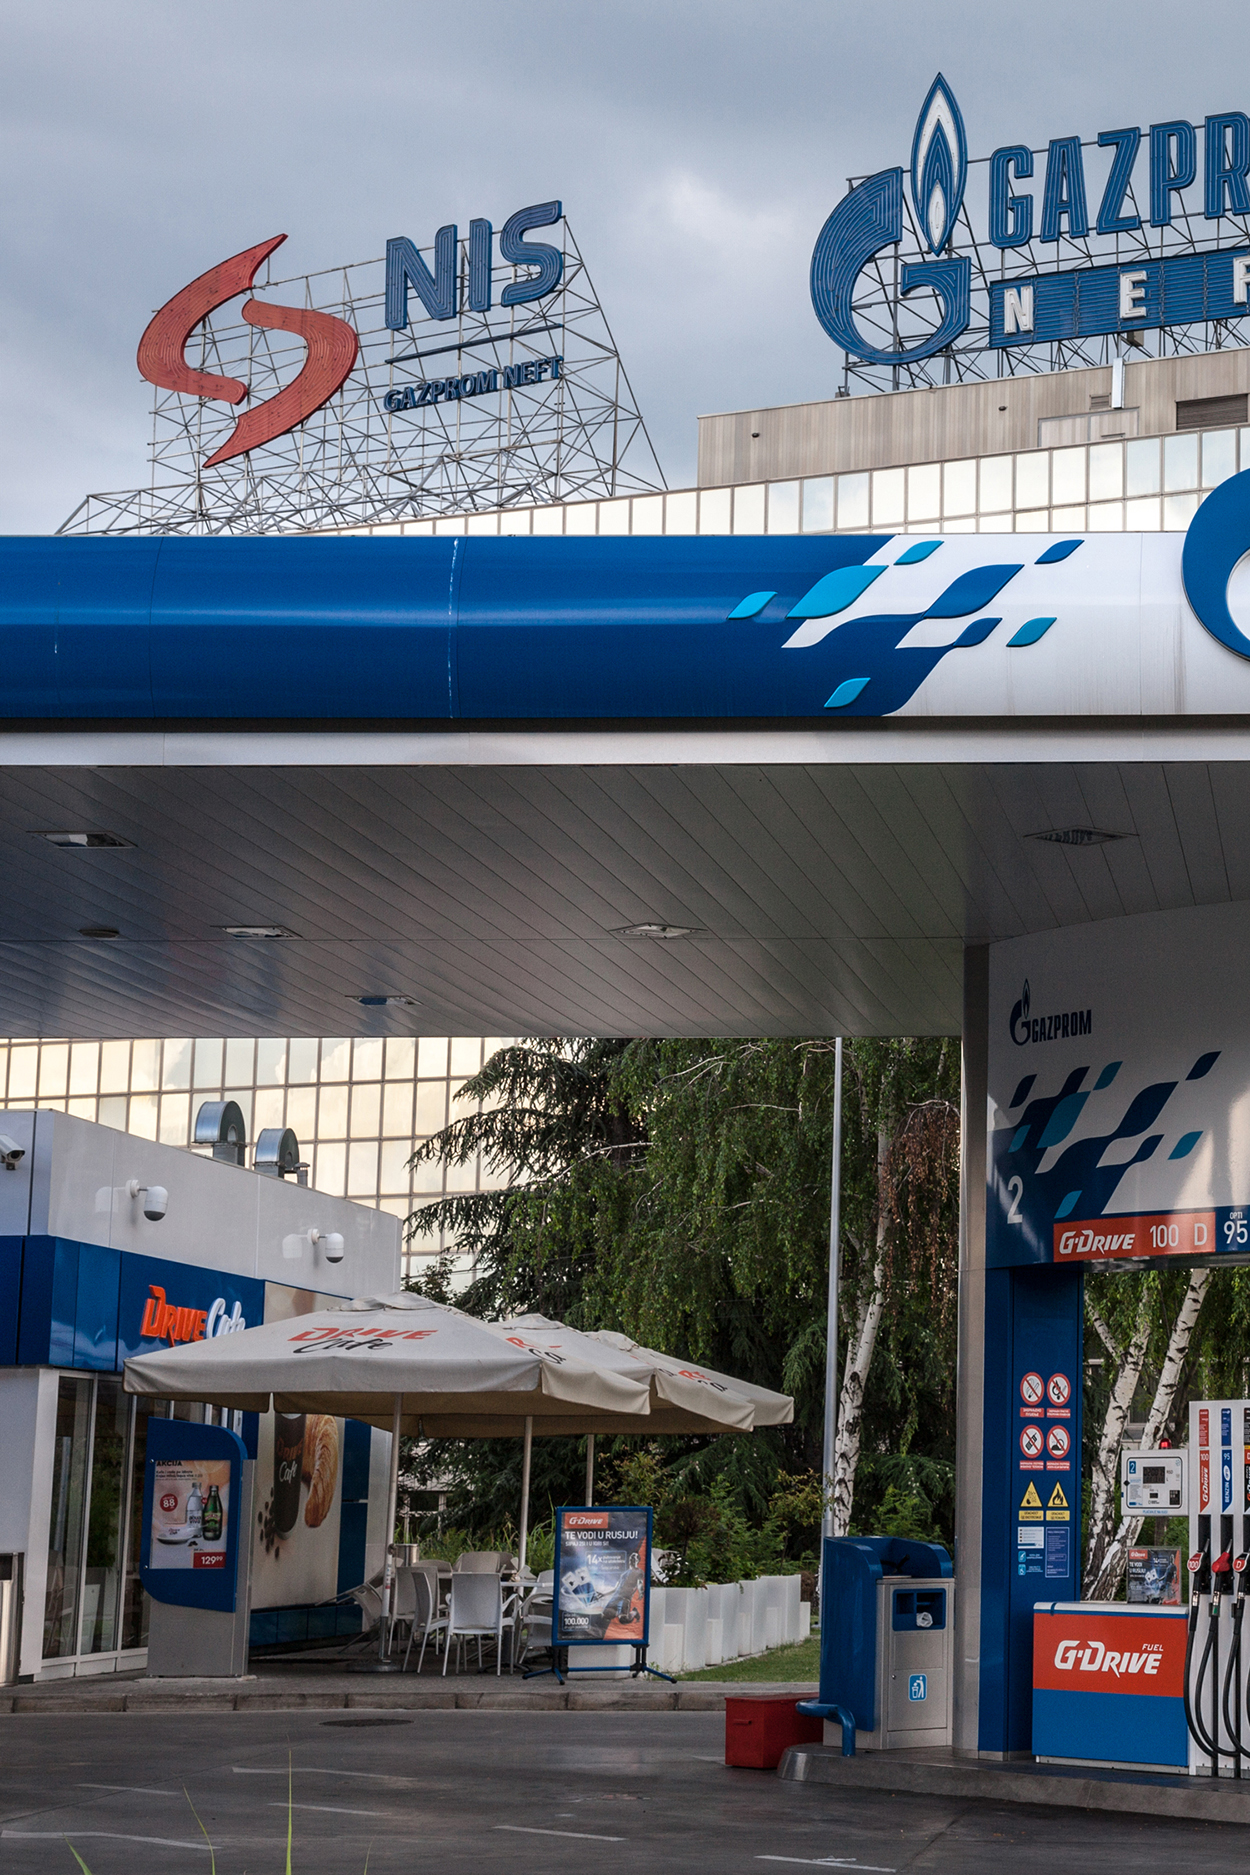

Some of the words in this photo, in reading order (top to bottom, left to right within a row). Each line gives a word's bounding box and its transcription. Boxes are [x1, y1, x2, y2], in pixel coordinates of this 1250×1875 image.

[385, 200, 563, 330] NIS
[384, 369, 498, 411] GAZPROM
[503, 355, 564, 389] NEFT
[1031, 1009, 1092, 1043] GAZPROM
[1006, 1175, 1024, 1225] 2
[1229, 1211, 1243, 1219] OPTI
[1150, 1224, 1179, 1248] 100
[1194, 1222, 1208, 1246] D
[1223, 1220, 1249, 1245] 95
[140, 1284, 208, 1348] DRIVE
[287, 1327, 439, 1342] DRIVE
[1200, 1453, 1209, 1461] 100
[1223, 1452, 1231, 1460] 95
[1130, 1462, 1136, 1473] 2
[163, 1498, 175, 1508] 88
[565, 1531, 576, 1540] TE
[577, 1531, 596, 1539] VODI
[597, 1531, 604, 1539] U
[605, 1530, 638, 1539] RUSIJU!
[1235, 1560, 1242, 1569] D
[1142, 1643, 1164, 1651] FUEL
